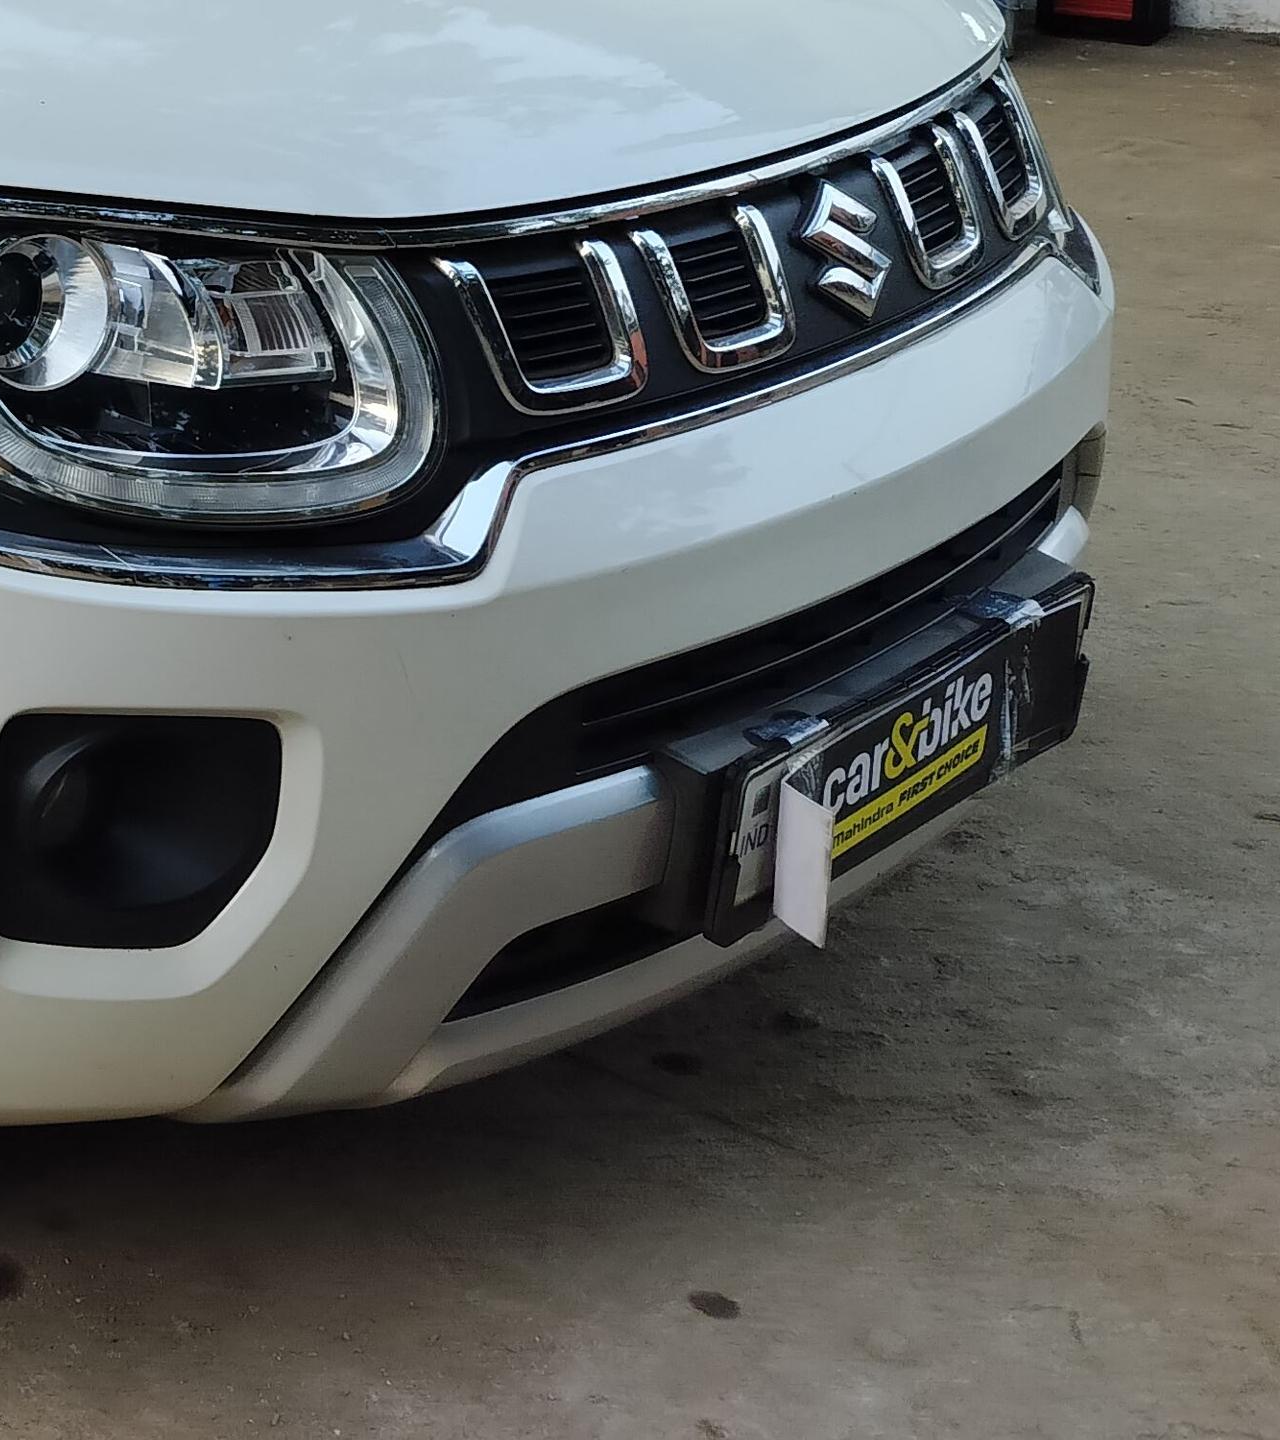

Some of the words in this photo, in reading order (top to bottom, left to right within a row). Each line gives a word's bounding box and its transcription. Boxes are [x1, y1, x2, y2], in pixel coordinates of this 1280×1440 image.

[822, 672, 993, 812] car&bike
[897, 770, 936, 808] FIRST
[936, 738, 980, 780] CHOICE
